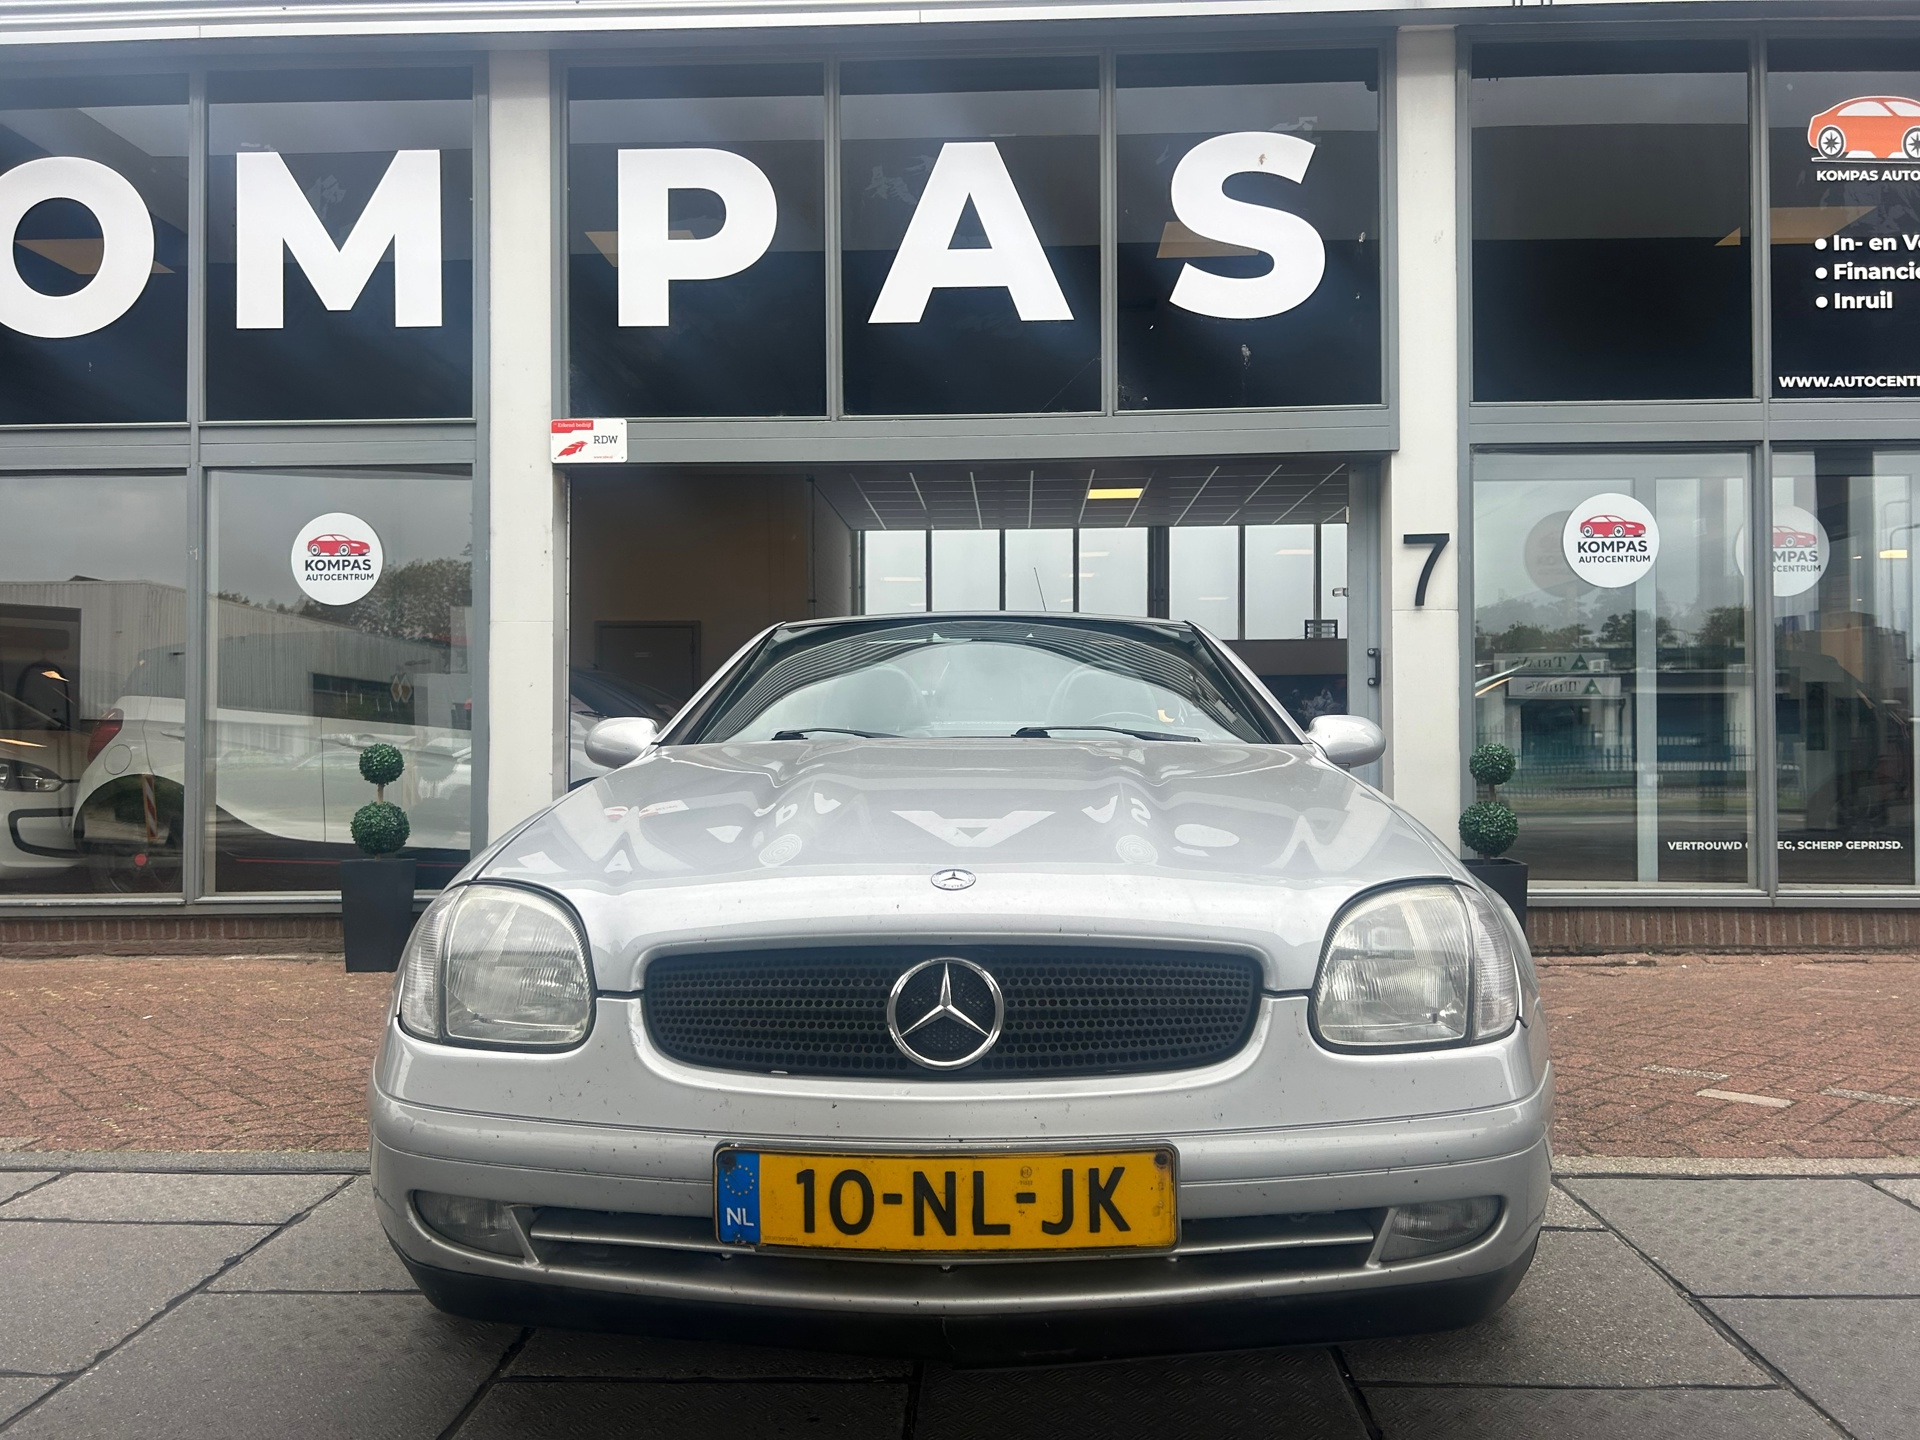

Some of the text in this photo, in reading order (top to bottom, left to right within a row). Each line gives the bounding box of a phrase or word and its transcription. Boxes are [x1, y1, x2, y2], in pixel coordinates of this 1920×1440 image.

[1816, 170, 1920, 181] KOMPAS AUTO
[1833, 234, 1920, 251] In- en V
[1834, 290, 1893, 309] Inruil
[1778, 375, 1920, 388] WWW.AUTOCENT
[593, 435, 618, 444] RDW
[1577, 540, 1648, 553] KOMPAS
[1578, 555, 1651, 563] AUTOCENTRUM
[1773, 550, 1818, 562] MPAS
[305, 559, 372, 571] KOMPAS
[1403, 533, 1450, 606] 7
[1773, 565, 1821, 573] CENTRUM
[305, 573, 375, 581] AUTOCENTRUM
[1667, 841, 1743, 850] VERTROUWD
[1777, 841, 1904, 851] EG, SCHERP GEPRIJSD.
[796, 1166, 1131, 1236] 10-NL-JK
[726, 1207, 754, 1227] NL
